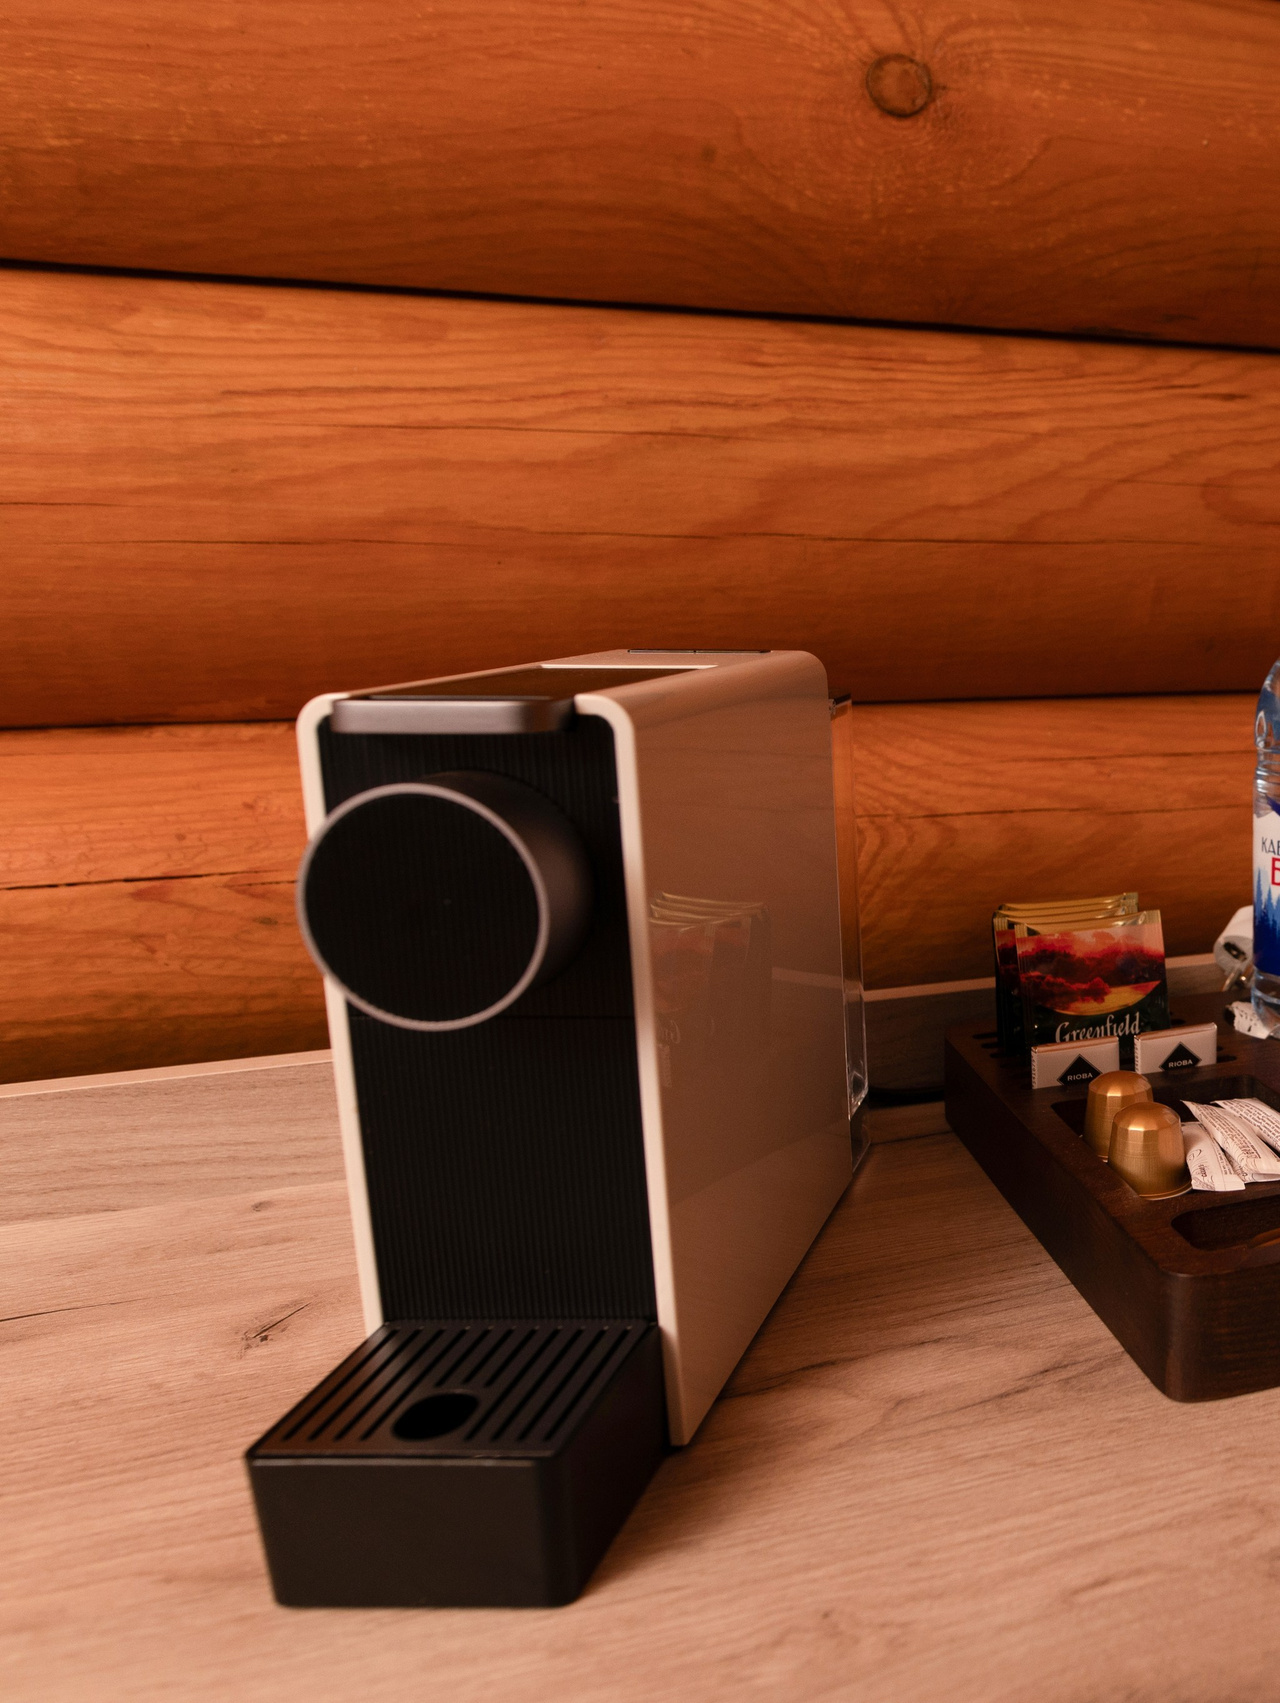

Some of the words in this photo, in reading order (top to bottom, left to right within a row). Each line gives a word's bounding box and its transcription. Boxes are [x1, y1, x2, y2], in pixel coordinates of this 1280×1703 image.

[1055, 1011, 1141, 1043] Greenfield
[1168, 1059, 1194, 1068] RIOBA
[1067, 1072, 1093, 1082] RIOBA
